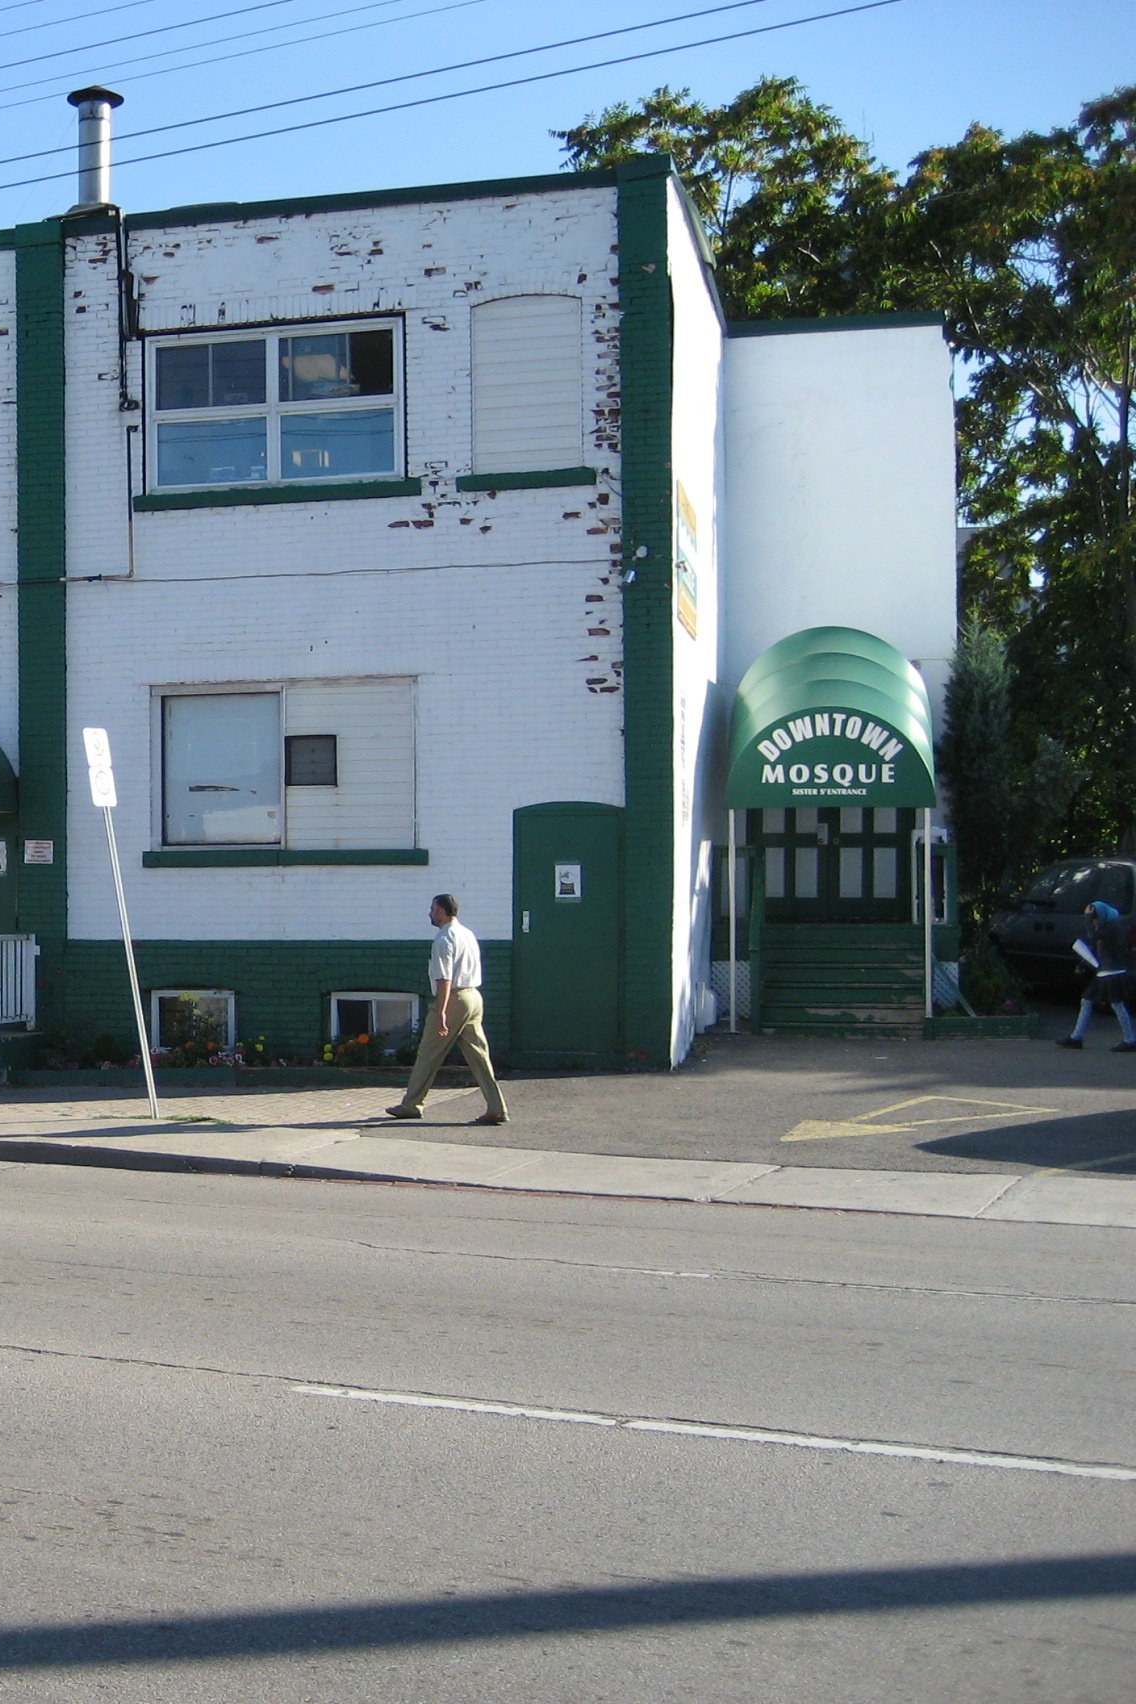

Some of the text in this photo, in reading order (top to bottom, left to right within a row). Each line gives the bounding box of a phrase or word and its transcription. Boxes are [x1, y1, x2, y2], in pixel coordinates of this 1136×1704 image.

[757, 713, 904, 762] DOWNTOWN
[761, 764, 895, 787] MOSQUE
[792, 788, 817, 796] SISTER
